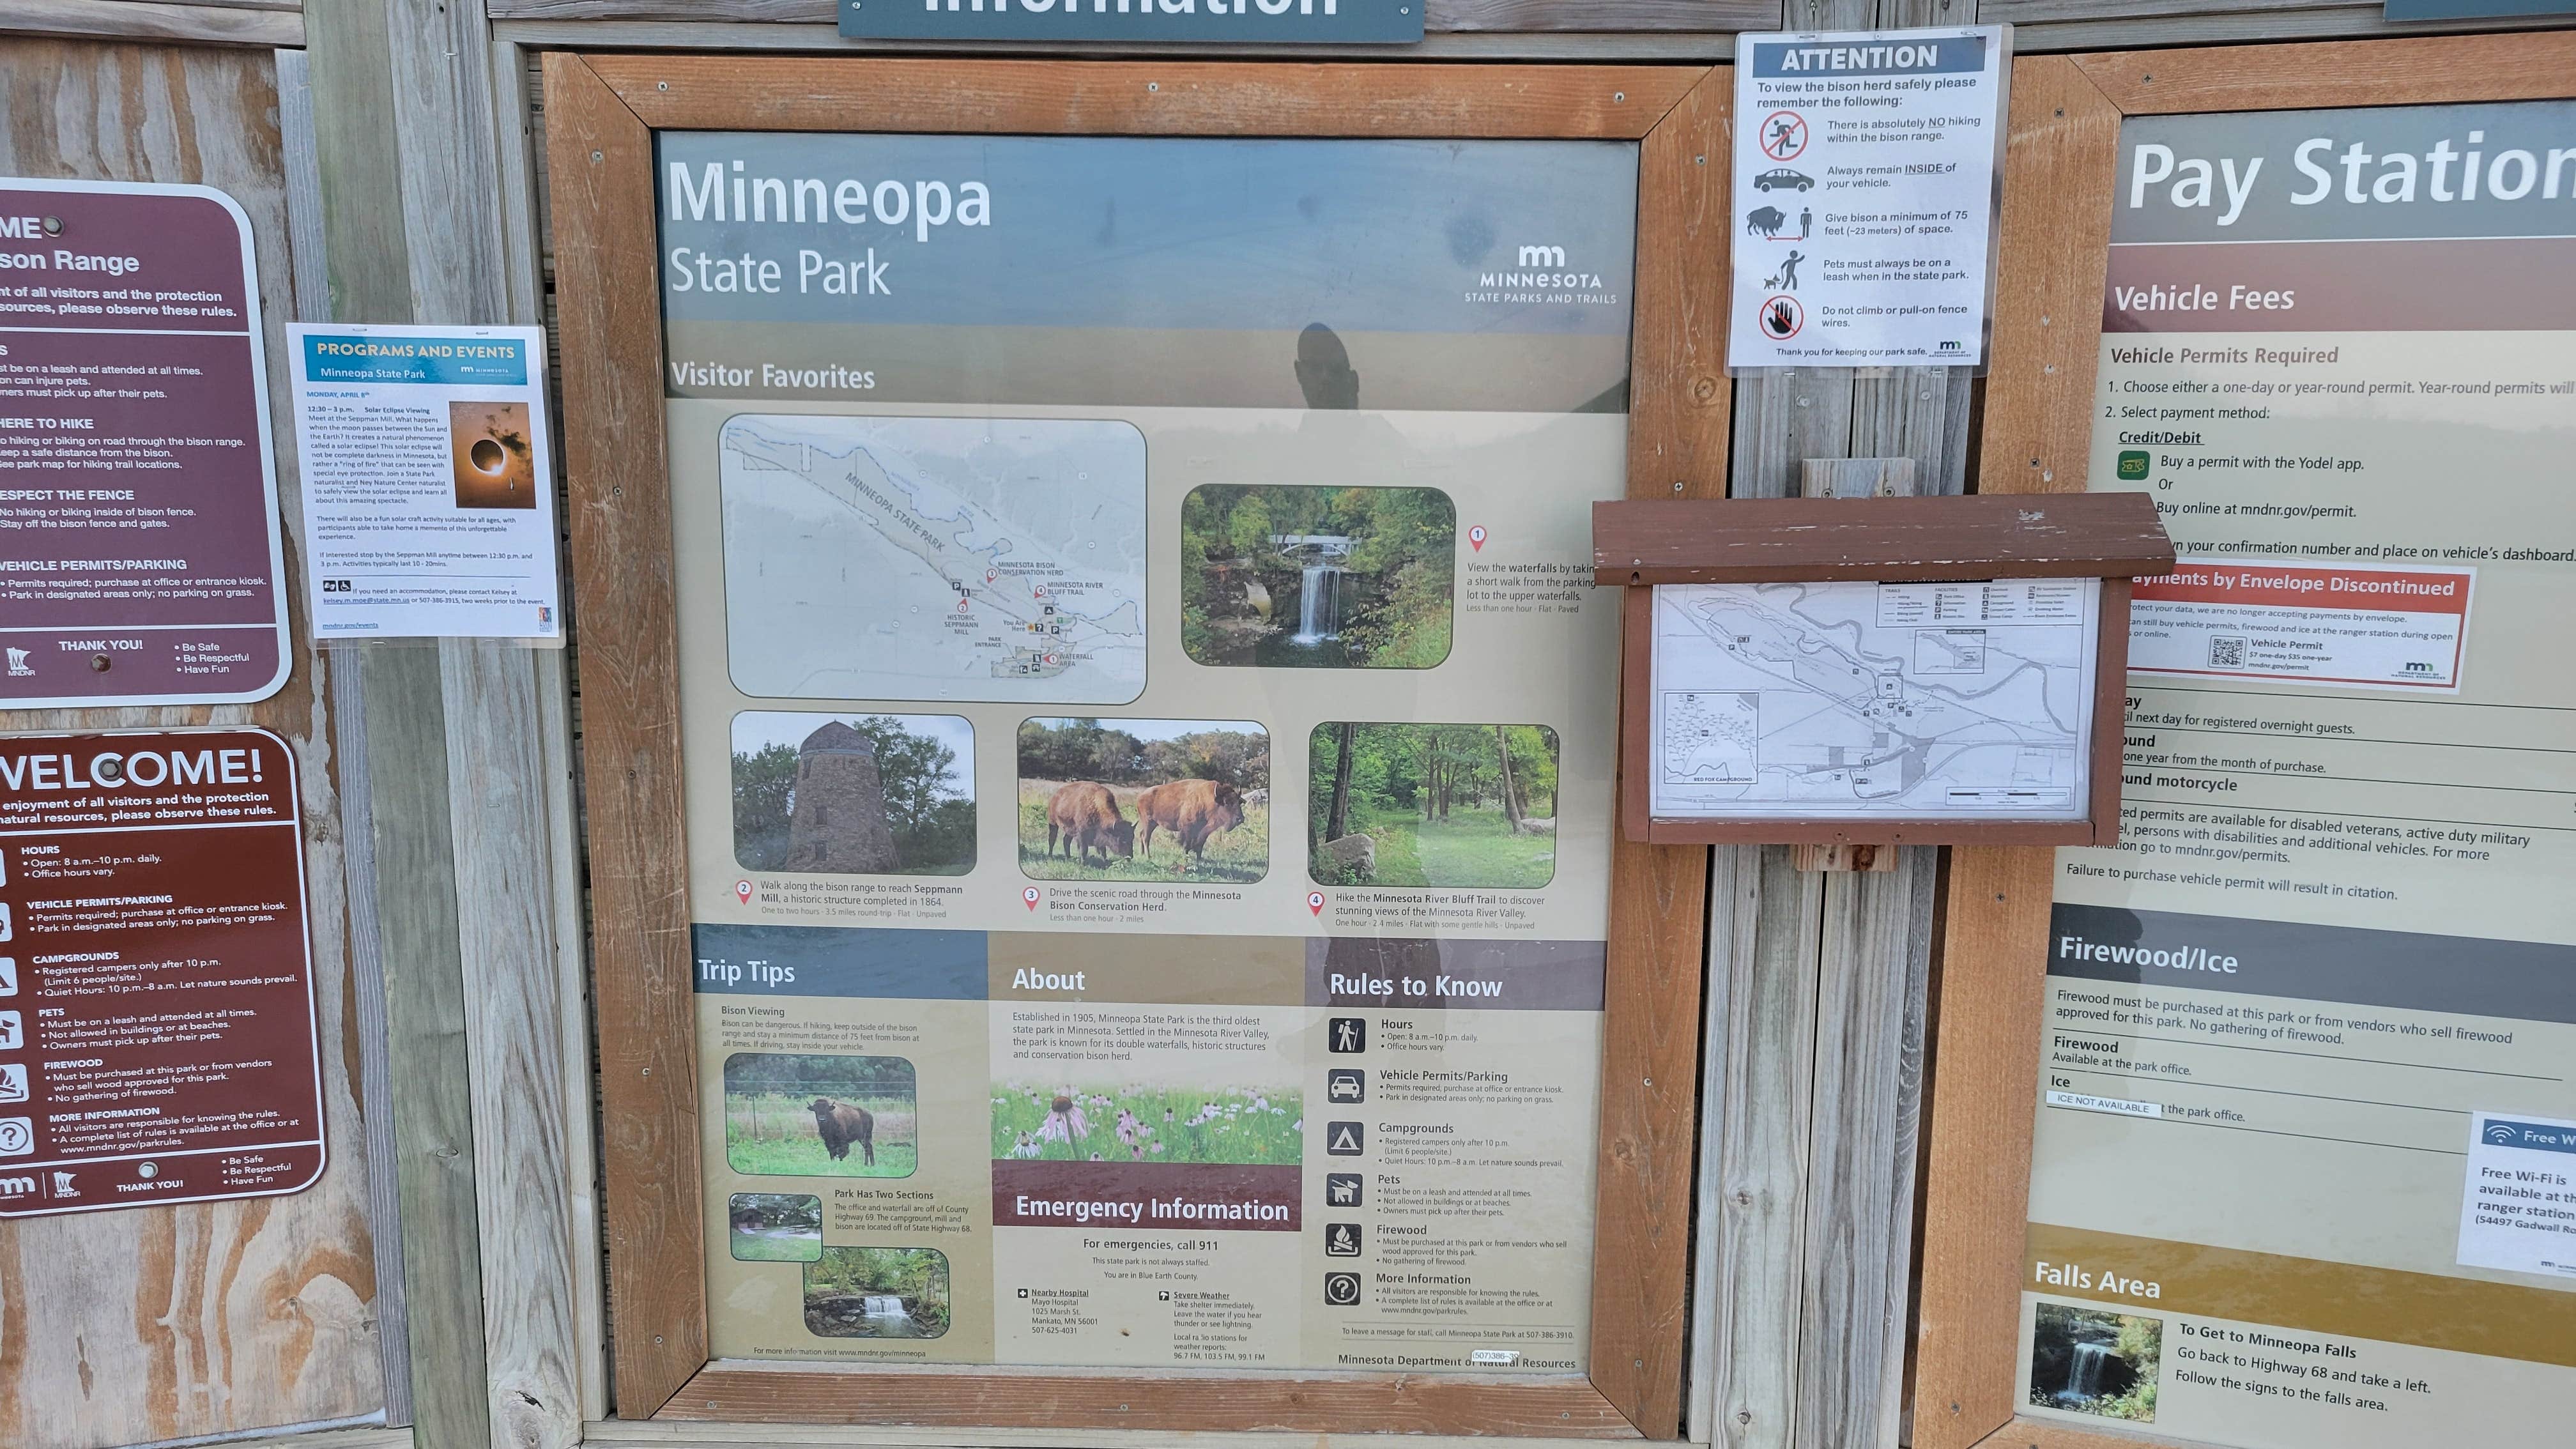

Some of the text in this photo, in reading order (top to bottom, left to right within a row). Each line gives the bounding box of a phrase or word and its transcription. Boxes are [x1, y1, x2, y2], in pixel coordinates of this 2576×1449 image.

[1781, 45, 1938, 71] ATTENTION
[1757, 77, 1977, 93] To view the bison herd safely please
[1757, 95, 1903, 108] remember the following:
[2129, 130, 2576, 226] Pay Station
[670, 160, 990, 242] Minneopa
[54, 250, 140, 277] Range
[671, 247, 891, 295] State Park
[14, 286, 222, 303] of all visitors and the protection
[1465, 293, 1616, 304] STATE PARKS AND TRAILS
[2115, 284, 2294, 311] Vehicle Fees
[317, 342, 515, 358] PROGRAMS AND EVENTS
[1804, 349, 1820, 358] you
[1821, 348, 1834, 356] for
[1835, 348, 1867, 358] keeping
[1885, 348, 1905, 357] park
[1906, 348, 1928, 357] safe.
[2111, 346, 2339, 367] Vehicle Permits Required
[321, 367, 425, 379] Minneopa State Park
[671, 361, 875, 389] Visitor Favorites
[405, 407, 431, 415] Viewing
[2104, 405, 2270, 422] 2. Select payment method:
[36, 418, 95, 429] TO HIKE
[2118, 431, 2203, 446] Credit/Debit
[2161, 455, 2364, 473] Buy a permit with the Yodel app.
[845, 472, 894, 515] MINNEOPA
[893, 509, 921, 536] STATE
[920, 530, 946, 552] PARK
[0, 559, 187, 571] VEHICLE PERMITS/PARKING
[2213, 571, 2455, 596] by Envelope Discontinued
[1467, 589, 1582, 602] lot to the upper waterfalls.
[58, 640, 143, 651] THANK YOU!
[182, 643, 220, 652] Be Safe
[2251, 638, 2323, 650] Vehicle Permit
[183, 653, 250, 664] Be Respectful
[184, 664, 230, 674] Have Fun
[21, 845, 60, 855] HOURS
[30, 859, 61, 869] Open:
[64, 857, 71, 866] 8
[113, 857, 135, 866] p.m.
[137, 854, 162, 864] daily.
[1050, 900, 1167, 912] Bison Conservation Herd.
[33, 951, 119, 964] CAMPGROUNDS
[2060, 936, 2238, 974] Firewood/Ice
[698, 959, 795, 988] Trip Tips
[1012, 967, 1085, 991] About
[1331, 972, 1503, 997] Rules to Know
[38, 1008, 65, 1018] PETS
[1381, 1018, 1413, 1029] Hours
[2054, 1036, 2119, 1054] Firewood
[1013, 1049, 1132, 1061] and conservation bison herd.
[44, 1059, 103, 1070] FIREWOOD
[2051, 1052, 2191, 1076] Available at the park office.
[1379, 1069, 1508, 1084] Vehicle Permits/Parking
[2057, 1094, 2150, 1114] ICE NOT AVAILABLE
[49, 1107, 160, 1123] MORE INFORMATION
[1379, 1123, 1454, 1135] Campgrounds
[60, 1137, 185, 1154] www.mndnr.gov/parkrules.
[1378, 1174, 1400, 1184] Pets
[2481, 1167, 2566, 1186] Free Wi-Fi is
[116, 1179, 183, 1192] THANK YOU!
[834, 1188, 934, 1200] Park Has Two Sections
[1016, 1195, 1288, 1223] Emergency Information
[1377, 1224, 1427, 1235] Firewood
[1084, 1238, 1218, 1252] For emergencies, call 911
[1376, 1273, 1471, 1285] More Information
[2034, 1262, 2160, 1299] Falls Area
[2180, 1322, 2356, 1359] To Get to Minneopa Falls
